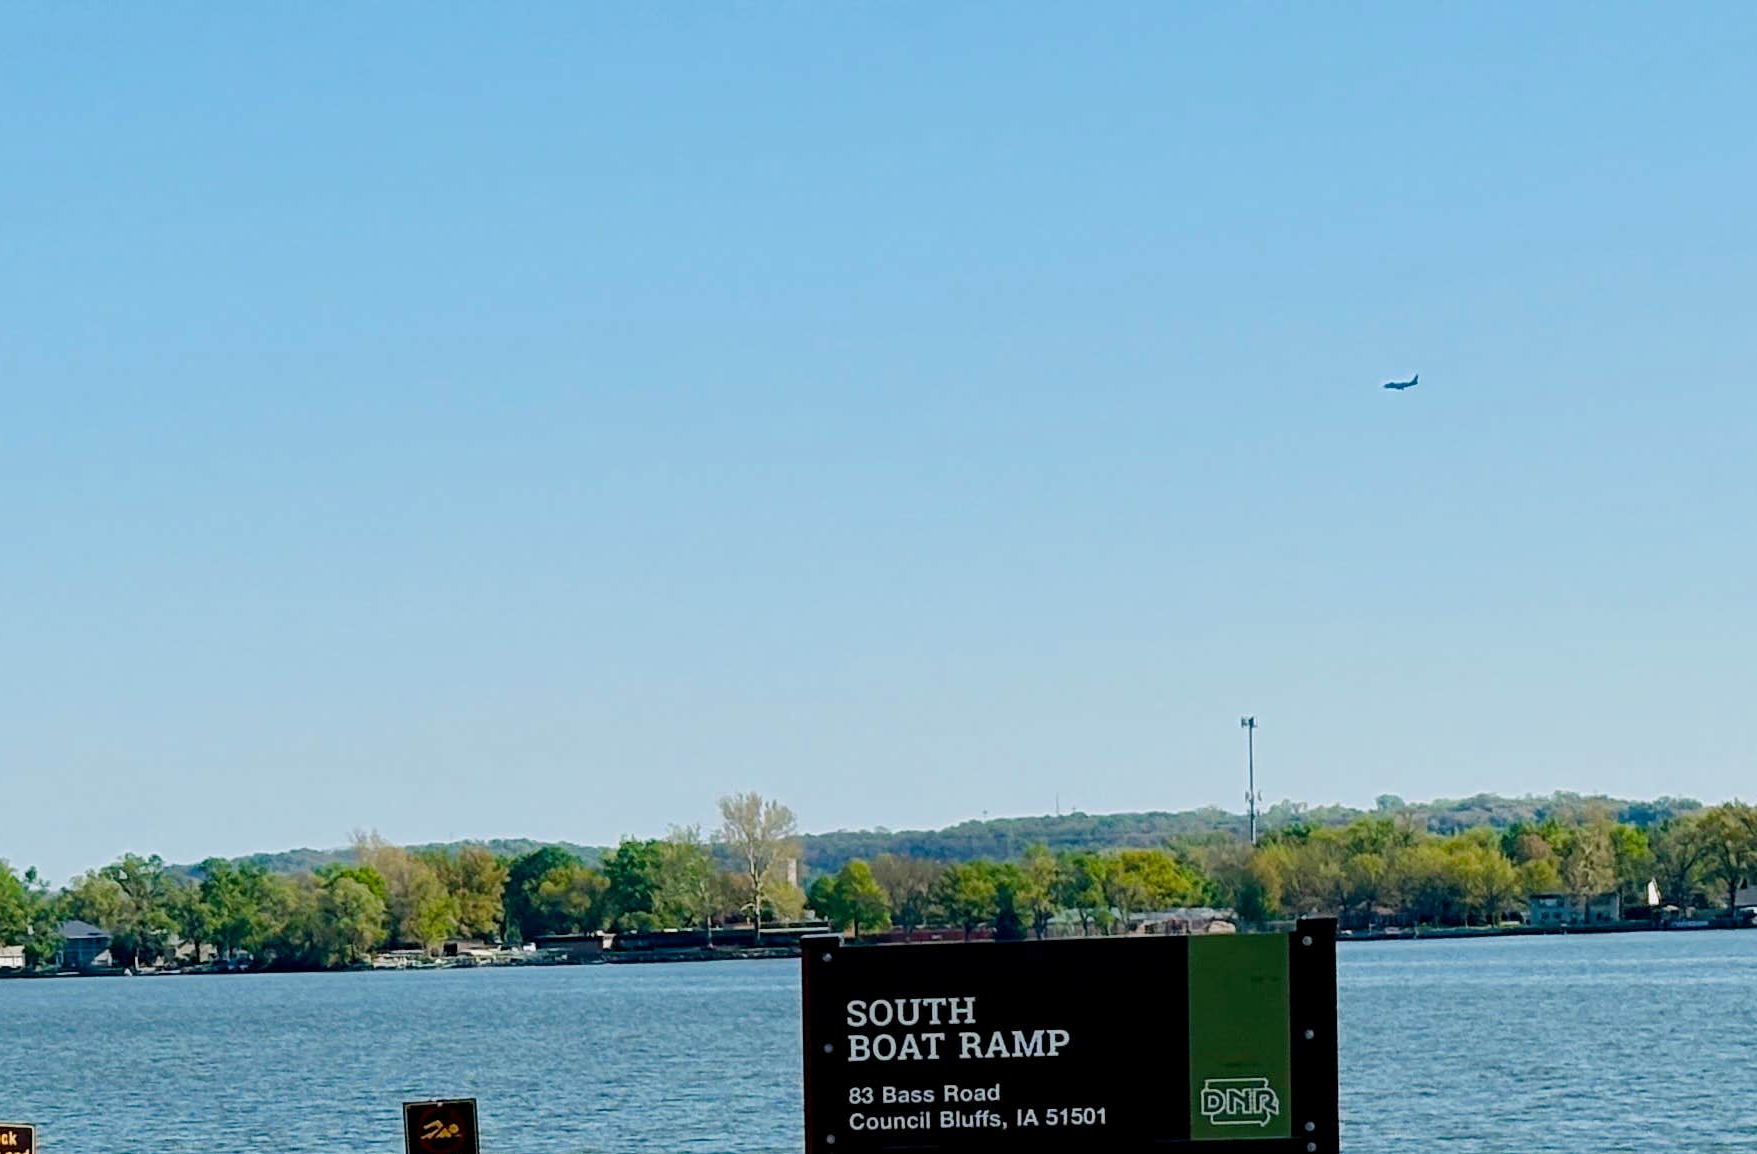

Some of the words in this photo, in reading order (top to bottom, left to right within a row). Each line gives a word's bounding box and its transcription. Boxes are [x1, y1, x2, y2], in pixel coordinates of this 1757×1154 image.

[846, 996, 977, 1027] SOUTH
[847, 1032, 945, 1062] BOAT
[958, 1029, 1071, 1059] RAMP
[848, 1086, 874, 1104] 83
[882, 1085, 935, 1103] Bass
[943, 1083, 1001, 1102] Road
[1200, 1087, 1280, 1116] DNR
[849, 1111, 932, 1131] Council
[939, 1109, 1008, 1131] Bluffs,
[1016, 1108, 1040, 1127] IA
[1045, 1107, 1107, 1127] 51501
